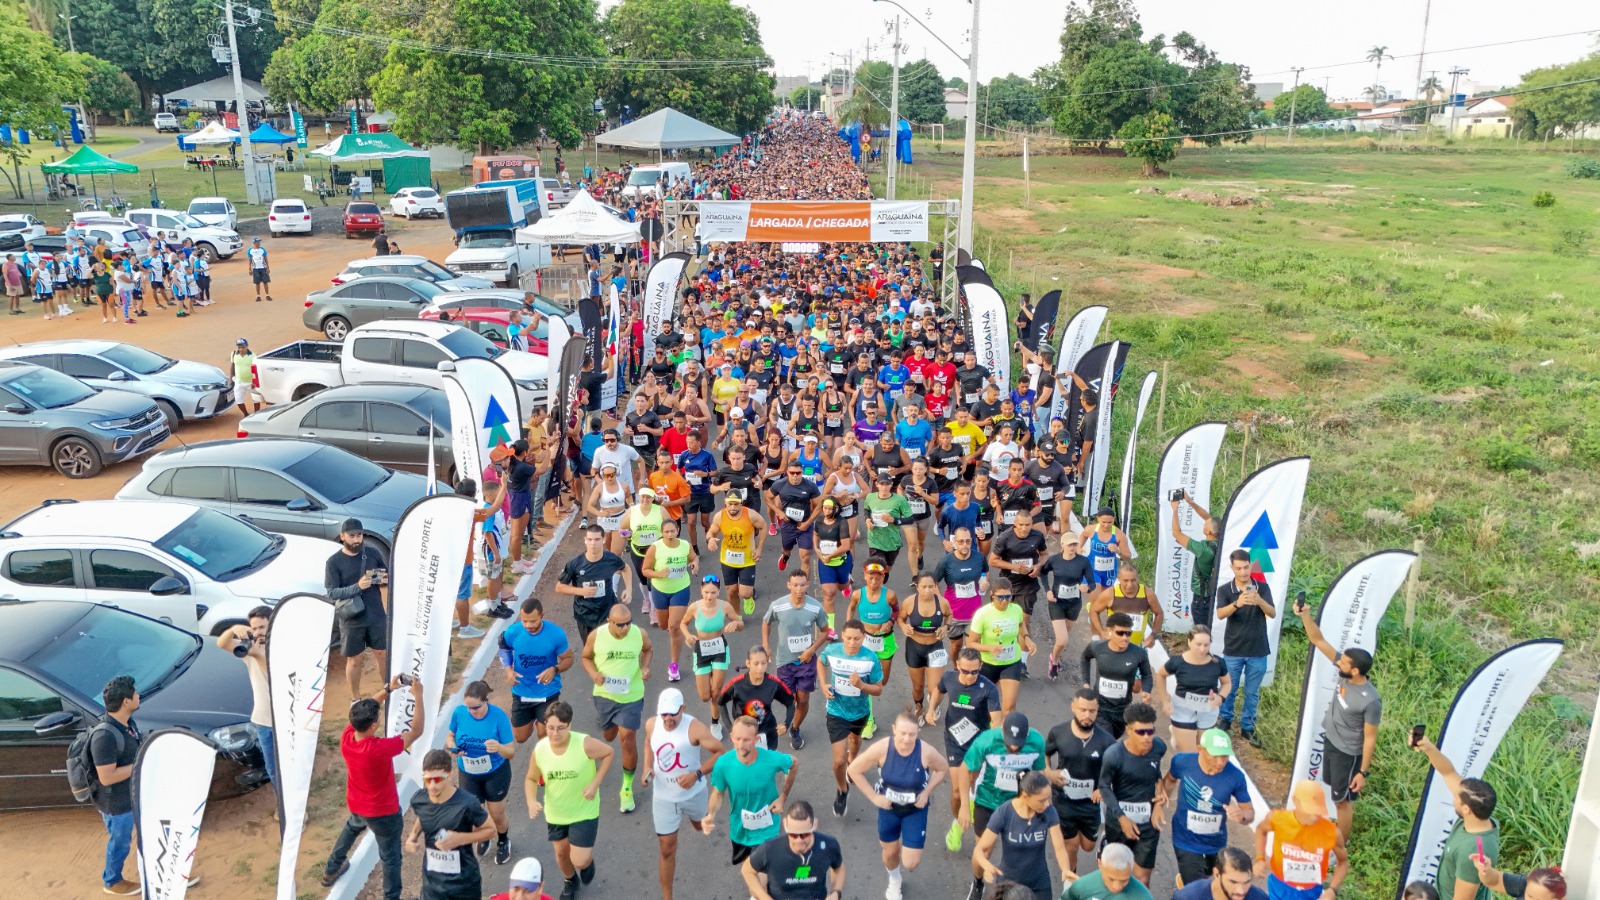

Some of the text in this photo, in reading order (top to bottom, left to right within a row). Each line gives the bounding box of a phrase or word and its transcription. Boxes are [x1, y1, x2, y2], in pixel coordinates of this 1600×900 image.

[751, 218, 803, 228] LARGADA
[814, 218, 869, 228] CHEGADA
[1183, 442, 1194, 475] ESPORTE,
[1190, 467, 1199, 489] LAZER
[420, 517, 434, 560] ESPORTE,
[429, 554, 441, 585] LAZER
[1349, 573, 1373, 615] ESPORTE,
[702, 640, 721, 648] 4241
[1102, 681, 1124, 690] 6833
[1480, 668, 1510, 717] ESPORTE,
[1068, 781, 1090, 789] 2844
[1122, 805, 1147, 814] 4836
[744, 810, 768, 821] 5354
[1191, 813, 1217, 823] 4604
[430, 851, 455, 861] 4083
[1281, 846, 1324, 862] UNIMED
[1287, 862, 1317, 871] 5274
